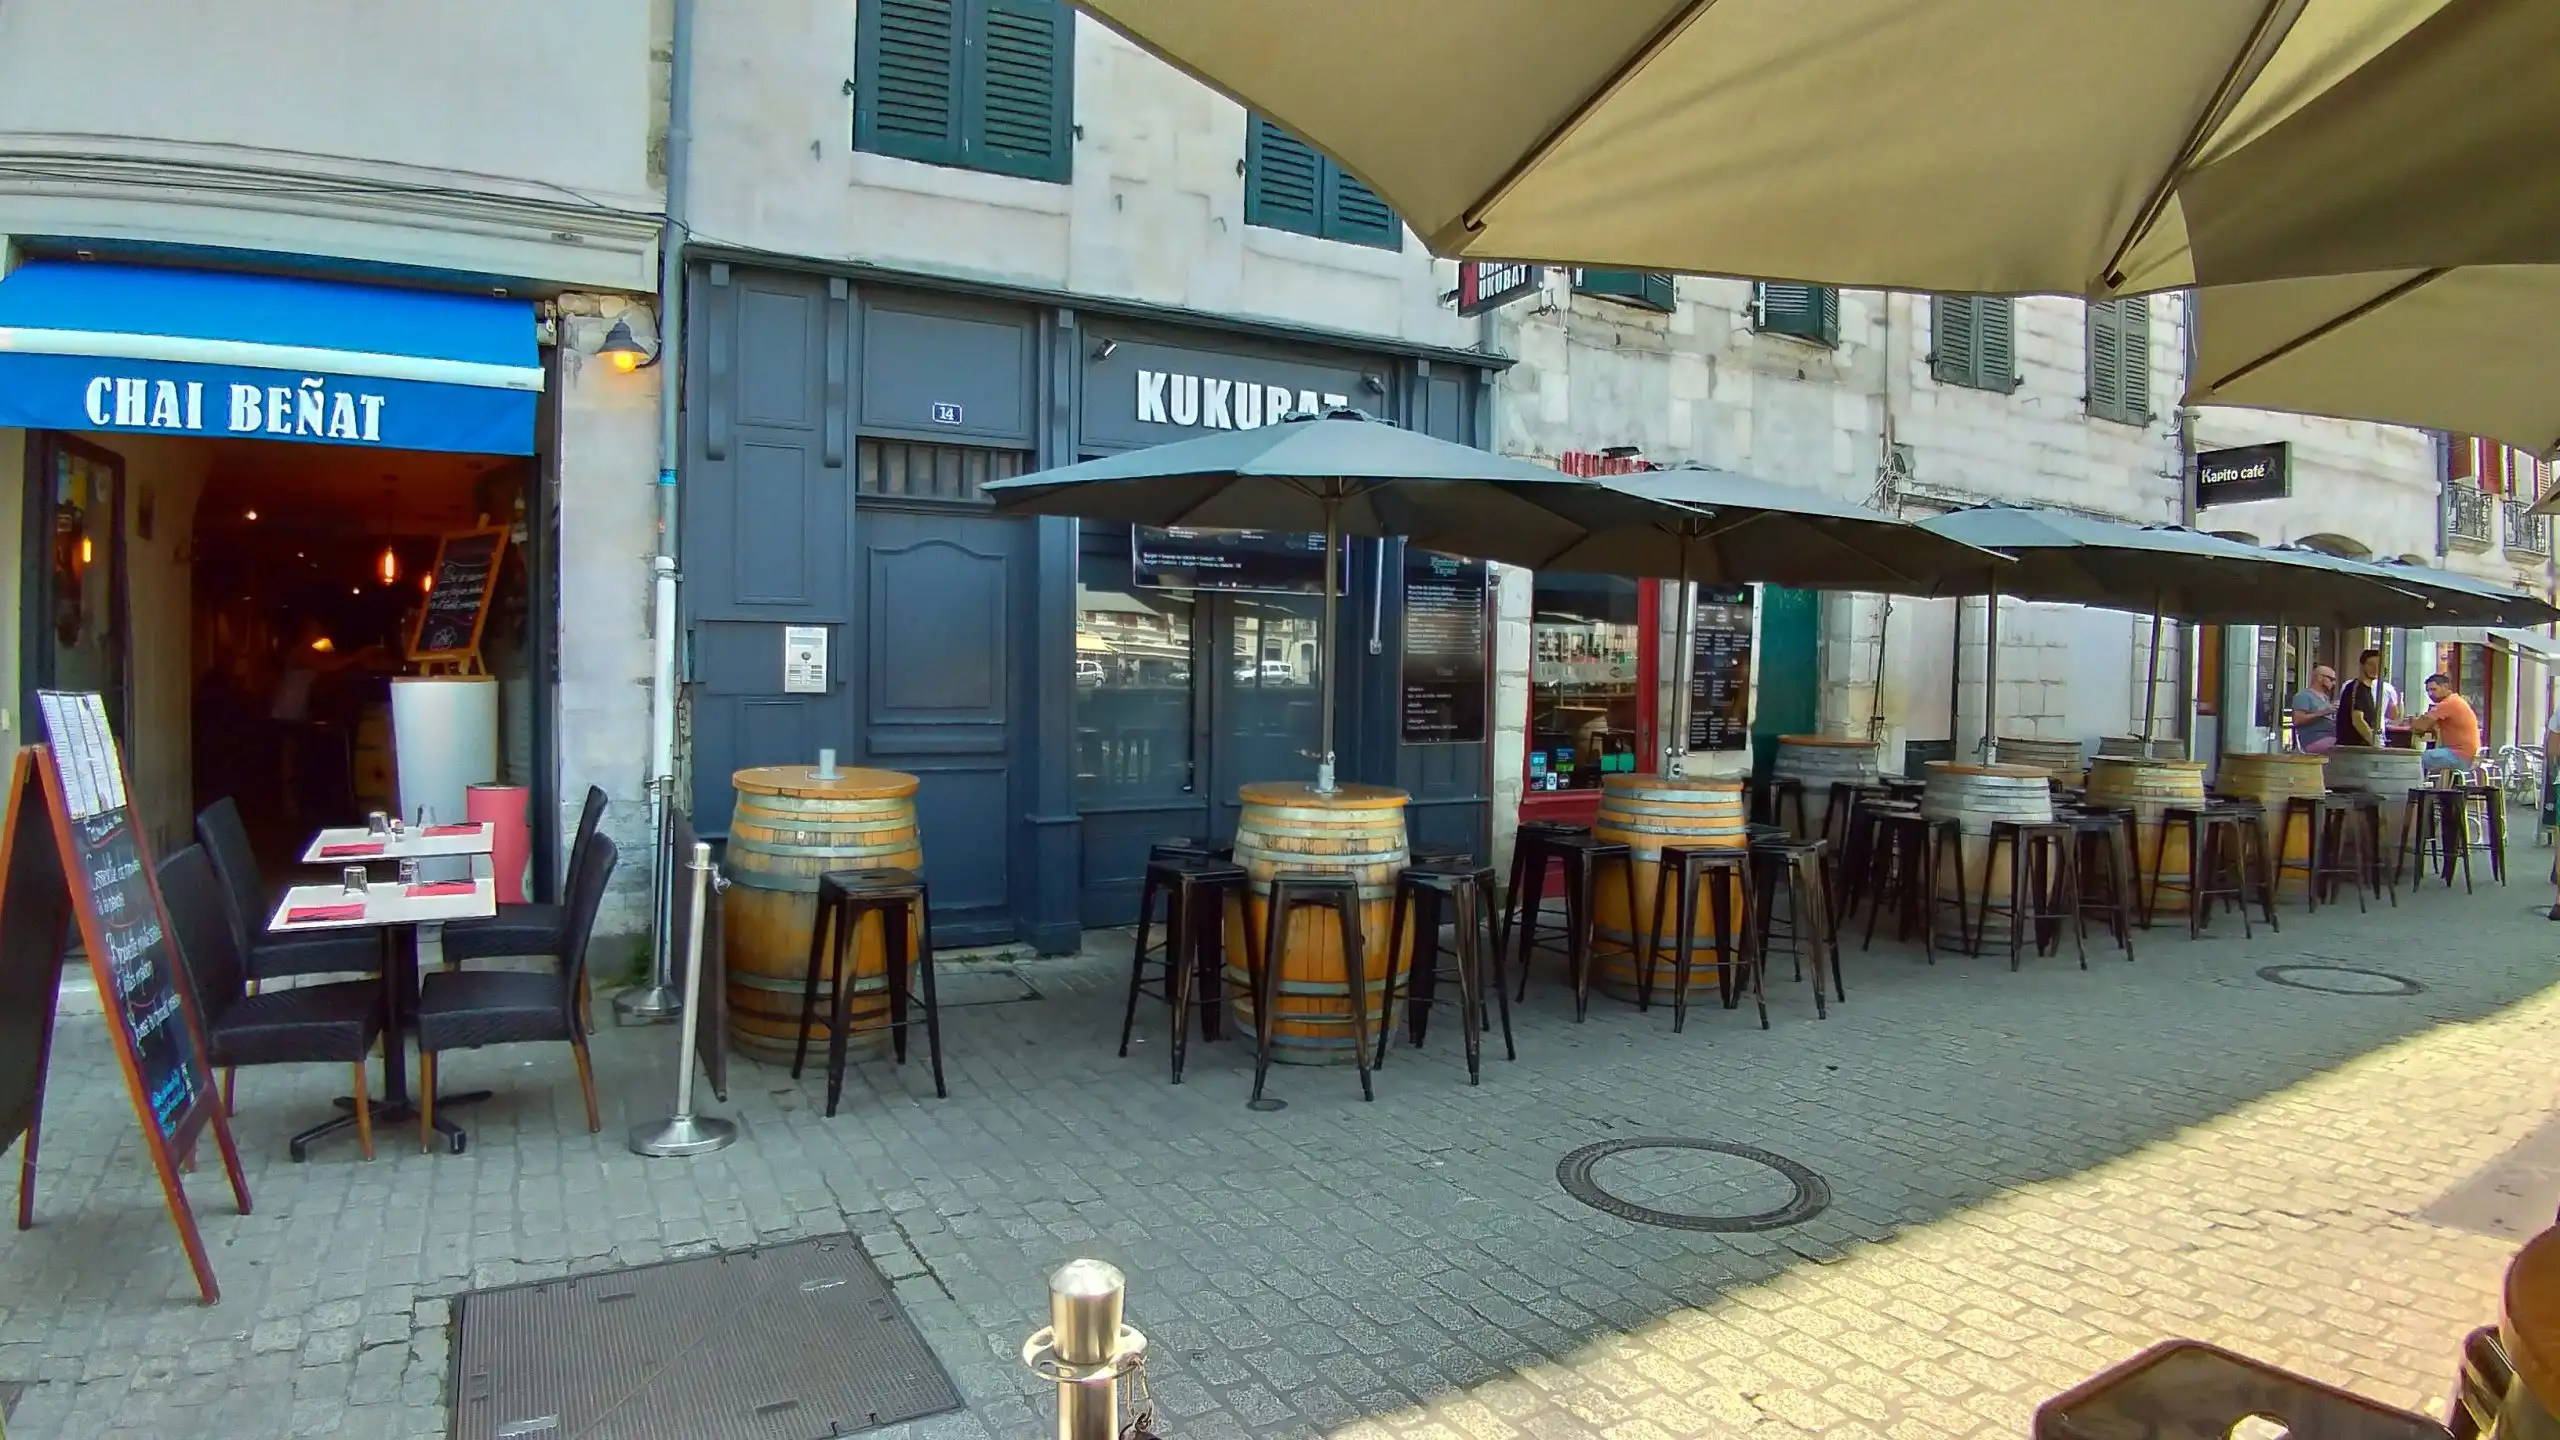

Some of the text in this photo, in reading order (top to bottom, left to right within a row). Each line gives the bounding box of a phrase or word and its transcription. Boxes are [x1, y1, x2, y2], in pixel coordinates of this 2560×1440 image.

[86, 376, 386, 441] CHAI BEÑAT
[940, 406, 955, 420] 14
[2201, 463, 2265, 484] Kapito café
